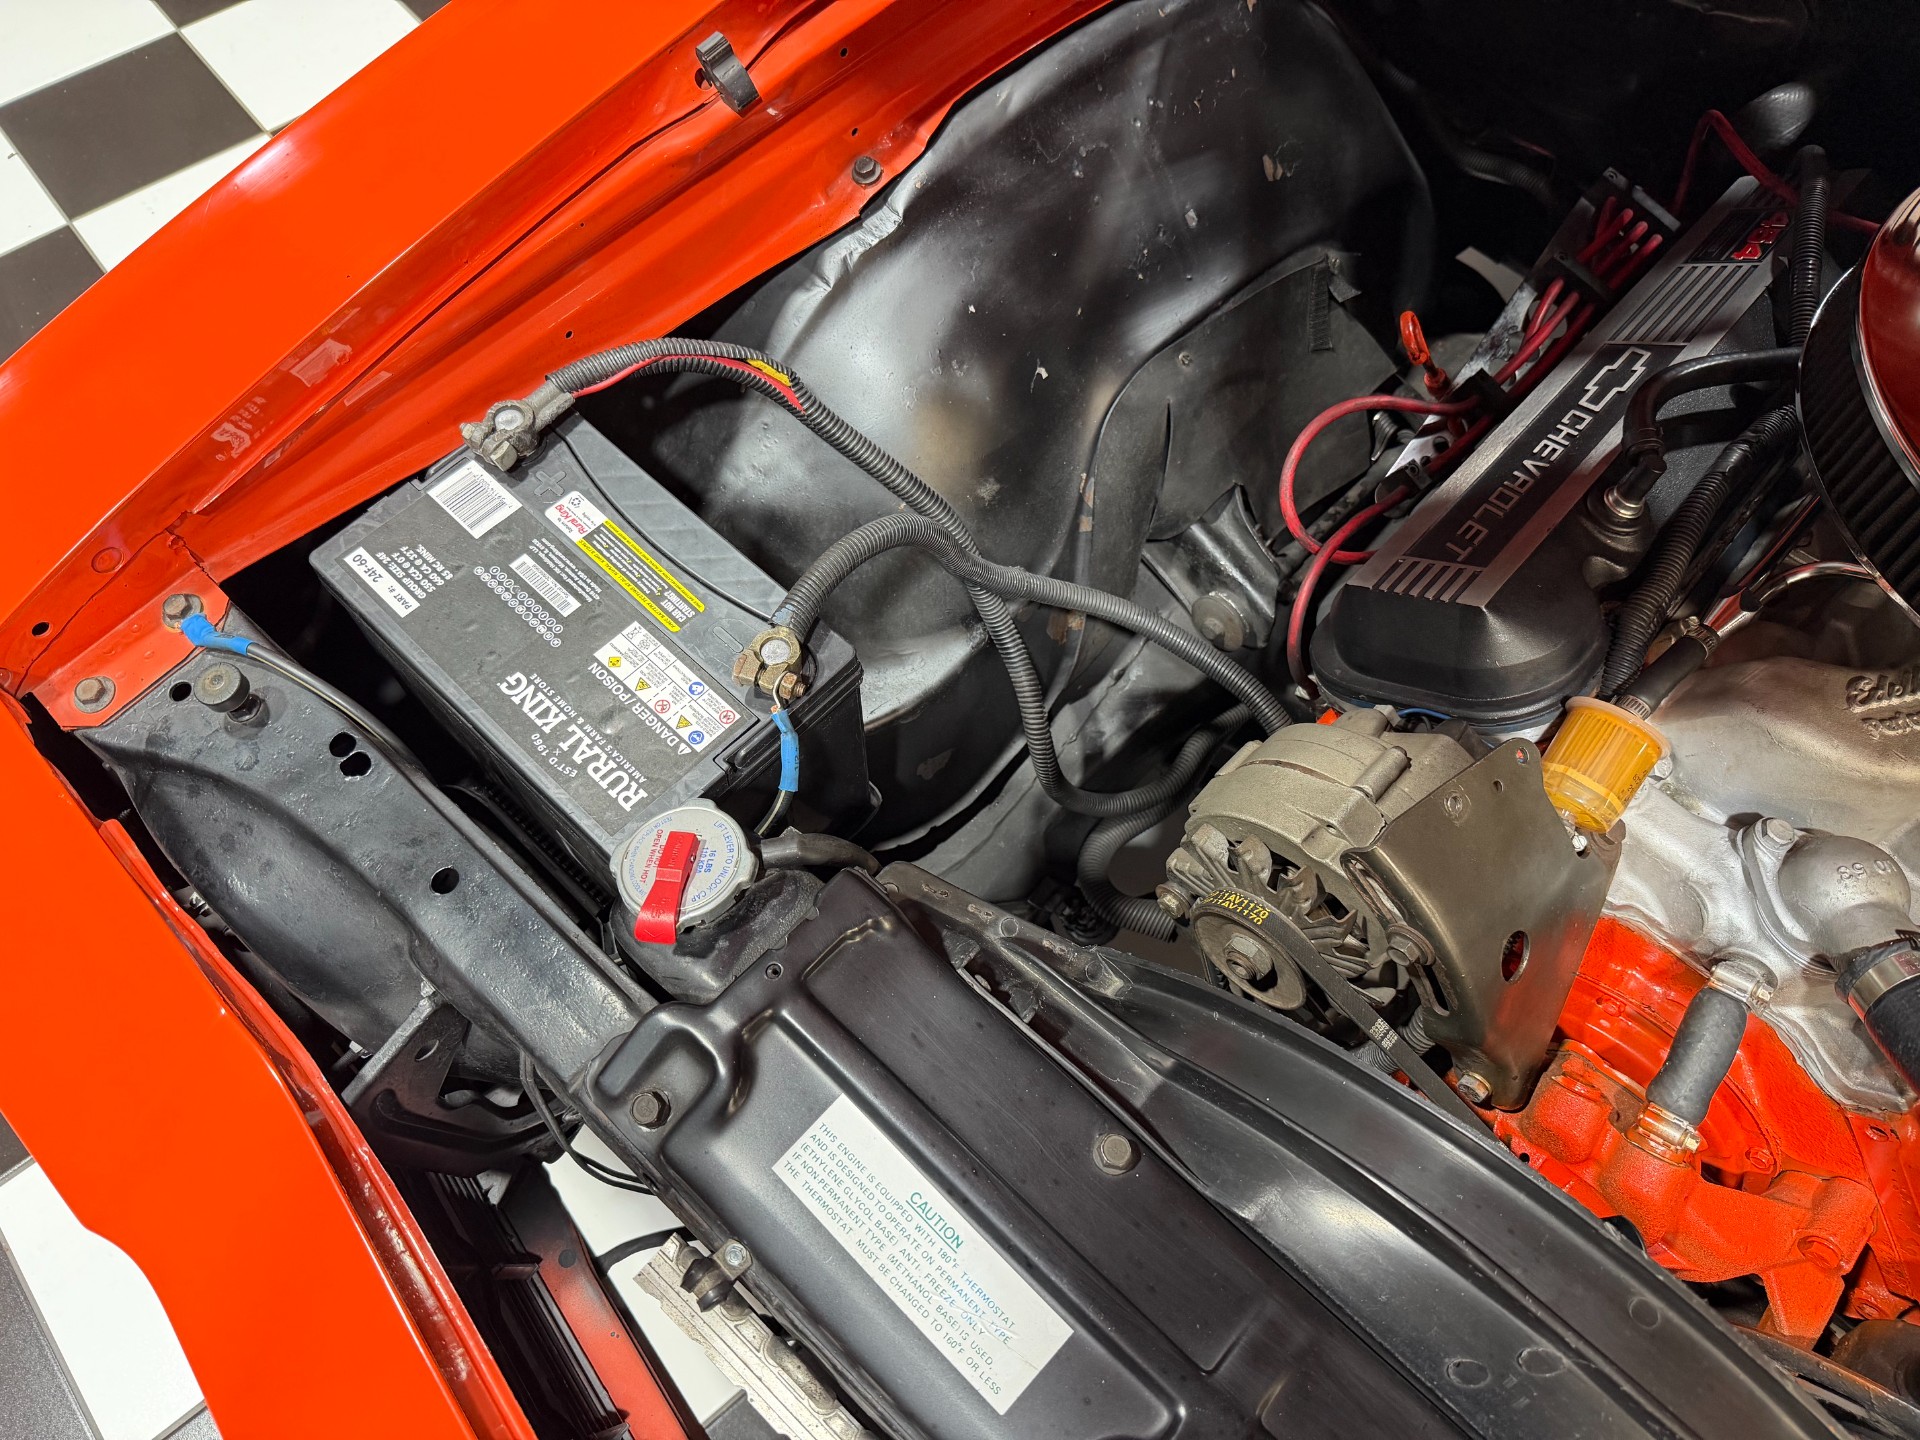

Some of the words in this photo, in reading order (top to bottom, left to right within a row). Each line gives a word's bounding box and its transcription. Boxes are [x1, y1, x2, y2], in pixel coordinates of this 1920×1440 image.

[1444, 406, 1590, 562] CHEVROLET
[554, 503, 571, 519] King
[567, 517, 587, 534] Rural
[375, 550, 391, 564] 24F
[413, 557, 423, 566] @
[415, 543, 436, 563] MINS.
[351, 553, 383, 583] 24F-60
[387, 561, 405, 578] SIZE:
[401, 561, 411, 569] @
[407, 566, 423, 581] CCA
[419, 563, 432, 574] CA
[431, 560, 444, 571] RC
[440, 569, 453, 580] 85
[401, 576, 427, 599] GROUP
[419, 578, 436, 593] 550
[428, 572, 445, 586] 660
[387, 585, 396, 593] #:
[393, 592, 412, 609] PART
[660, 598, 675, 611] NOT
[663, 589, 695, 617] STARTING?
[671, 608, 686, 622] CAR
[529, 673, 554, 695] STORE
[498, 671, 567, 734] KING
[553, 695, 577, 717] HOME
[576, 716, 584, 724] &
[631, 702, 679, 746] DANGER
[582, 723, 606, 744] FARM
[530, 732, 549, 756] 1960
[548, 755, 577, 777] EST'D
[558, 723, 648, 811] RURAL
[604, 744, 646, 782] AMERICA'S
[652, 829, 663, 847] OPEN
[723, 831, 734, 853] LEVER
[644, 849, 656, 868] WHEN
[704, 859, 713, 872] LBS
[725, 855, 733, 864] TO
[640, 870, 649, 882] HOT
[706, 866, 729, 892] UNLOCK
[691, 890, 706, 901] CAP
[799, 1141, 844, 1188] (ETHYLENE
[841, 1185, 875, 1220] GLYCOL
[873, 1219, 899, 1246] BASE)
[923, 1272, 957, 1308] FREEZE
[809, 1132, 828, 1152] AND
[826, 1151, 837, 1161] IS
[835, 1159, 875, 1201] DESIGNED
[873, 1200, 886, 1213] TO
[884, 1211, 921, 1250] OPERATE
[920, 1250, 935, 1265] ON
[934, 1264, 985, 1318] PERMANENT
[818, 1123, 837, 1143] THIS
[836, 1142, 867, 1173] ENGINE
[865, 1172, 876, 1183] IS
[874, 1181, 914, 1223] EQUIPPED
[913, 1223, 936, 1247] WITH
[959, 1271, 1015, 1330] THERMOSTAT
[908, 1190, 964, 1249] CAUTION
[791, 1151, 802, 1161] IF
[799, 1159, 866, 1229] NON-PERMANENT
[863, 1228, 887, 1251] TYPE
[886, 1252, 935, 1304] (METHANOL
[934, 1304, 961, 1331] BASE)
[958, 1329, 970, 1340] IS
[968, 1340, 996, 1369] USED,
[782, 1160, 800, 1179] THE
[800, 1179, 853, 1235] THERMOSTAT
[855, 1238, 879, 1263] MUST
[877, 1263, 890, 1276] BE
[888, 1275, 933, 1322] CHANGED
[929, 1318, 943, 1332] TO
[964, 1356, 980, 1372] OR
[977, 1370, 1002, 1395] LESS
